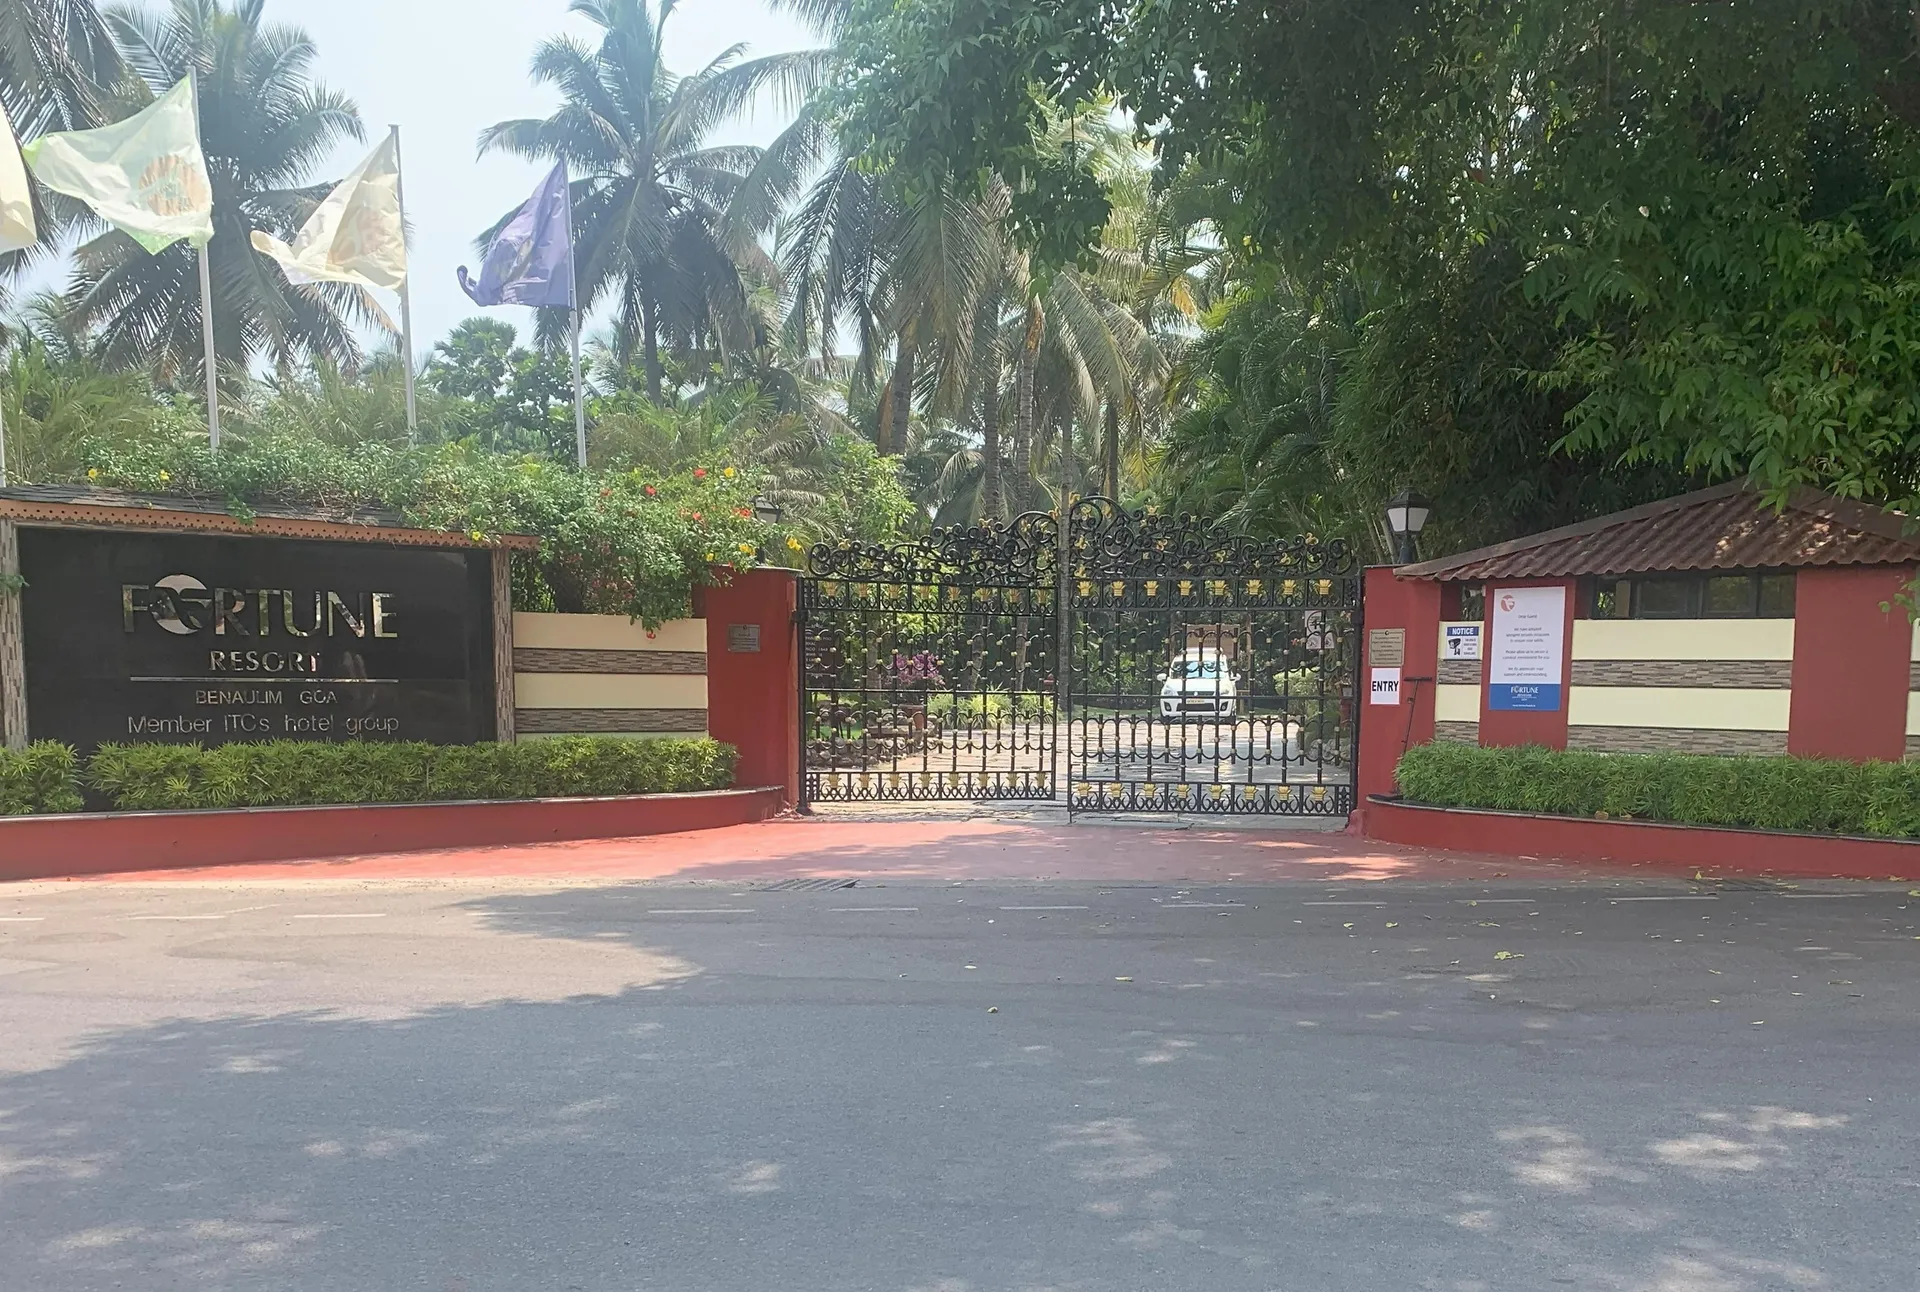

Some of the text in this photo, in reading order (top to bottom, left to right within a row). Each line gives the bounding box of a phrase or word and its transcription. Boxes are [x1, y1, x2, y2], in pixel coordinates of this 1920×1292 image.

[122, 574, 398, 637] FORTUNE
[1452, 627, 1474, 635] NOTICE
[209, 650, 320, 672] RESORT
[1372, 681, 1399, 692] ENTRY
[1510, 685, 1539, 694] FORTUNE
[195, 689, 338, 705] BENAULIM GOA
[127, 715, 213, 734] Member
[284, 714, 334, 732] hotel
[345, 717, 400, 735] group
